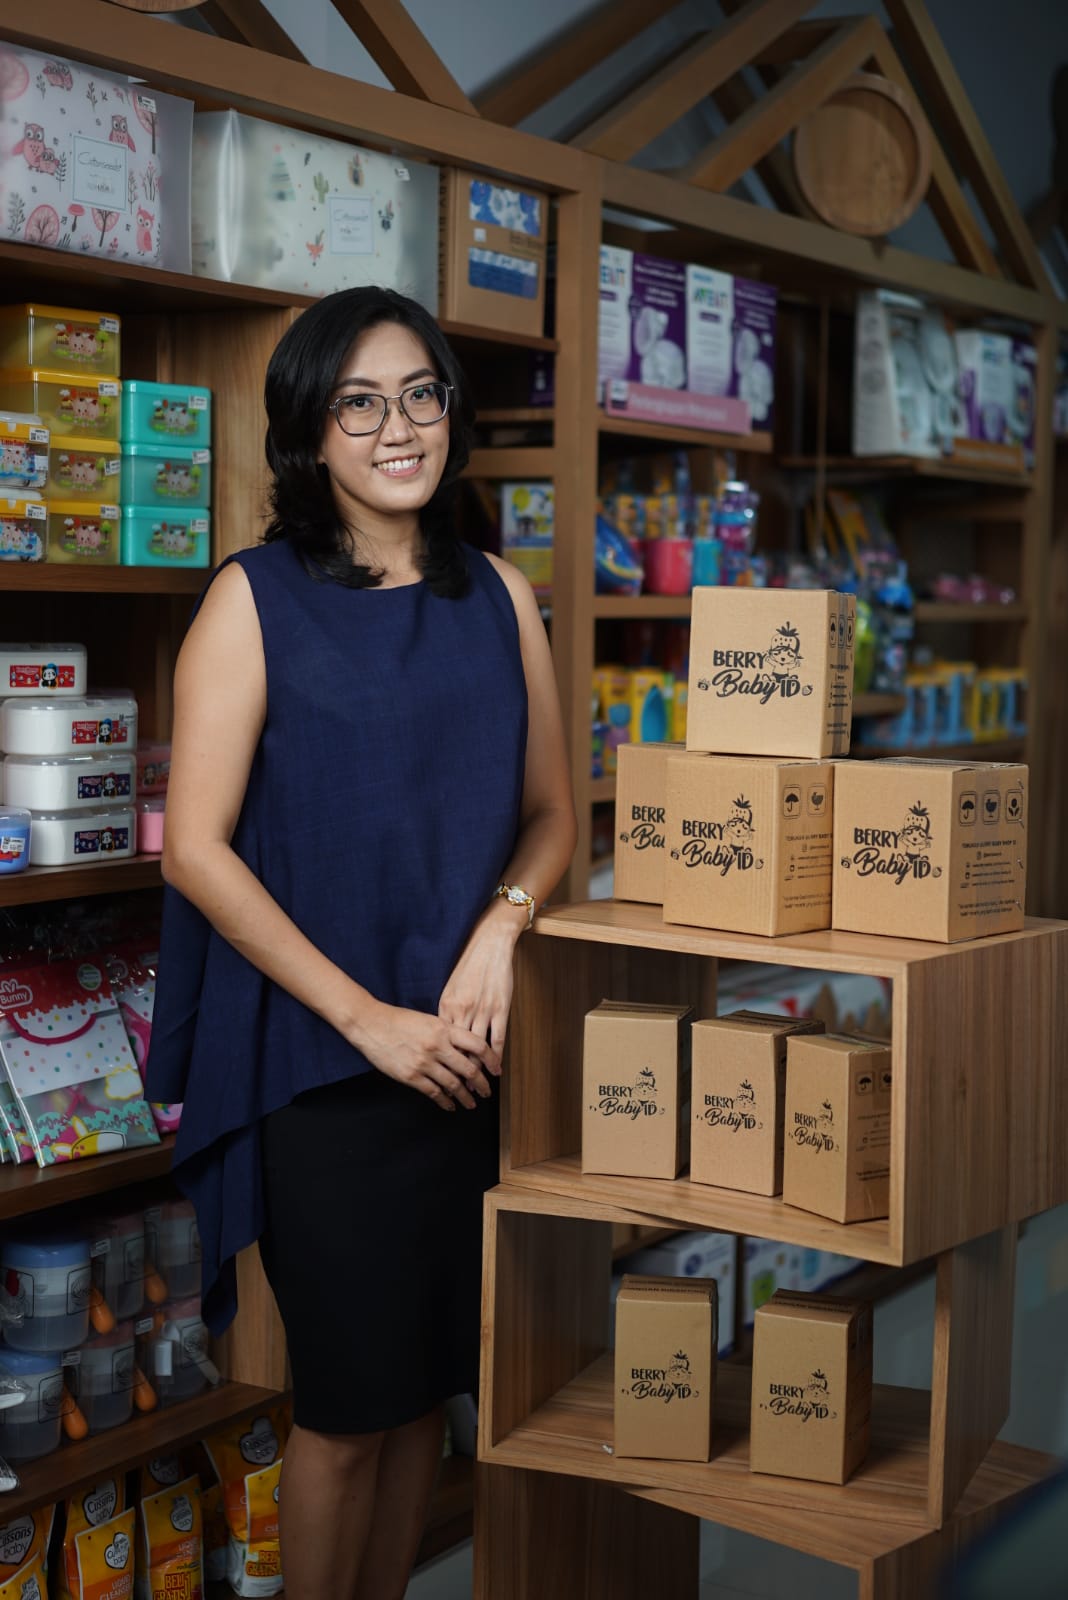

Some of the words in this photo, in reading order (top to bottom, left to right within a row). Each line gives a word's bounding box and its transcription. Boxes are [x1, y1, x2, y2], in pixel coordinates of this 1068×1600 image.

[713, 650, 767, 670] BERRY
[711, 669, 780, 704] Baby
[780, 678, 800, 698] ID
[631, 805, 665, 823] BERR
[682, 819, 726, 840] BERRY
[853, 827, 901, 848] BERRY
[682, 839, 737, 877] Baby
[737, 851, 754, 870] ID
[853, 847, 912, 885] Baby
[913, 860, 931, 879] ID
[598, 1085, 633, 1098] BERRY
[704, 1094, 735, 1109] BERRY
[598, 1097, 643, 1120] Baby
[704, 1108, 745, 1133] Baby
[794, 1112, 818, 1129] BERRY
[794, 1127, 824, 1154] Baby
[631, 1368, 668, 1381] BERRY
[631, 1380, 678, 1403] Baby
[769, 1384, 806, 1399] BERRY
[769, 1397, 815, 1422] Baby
